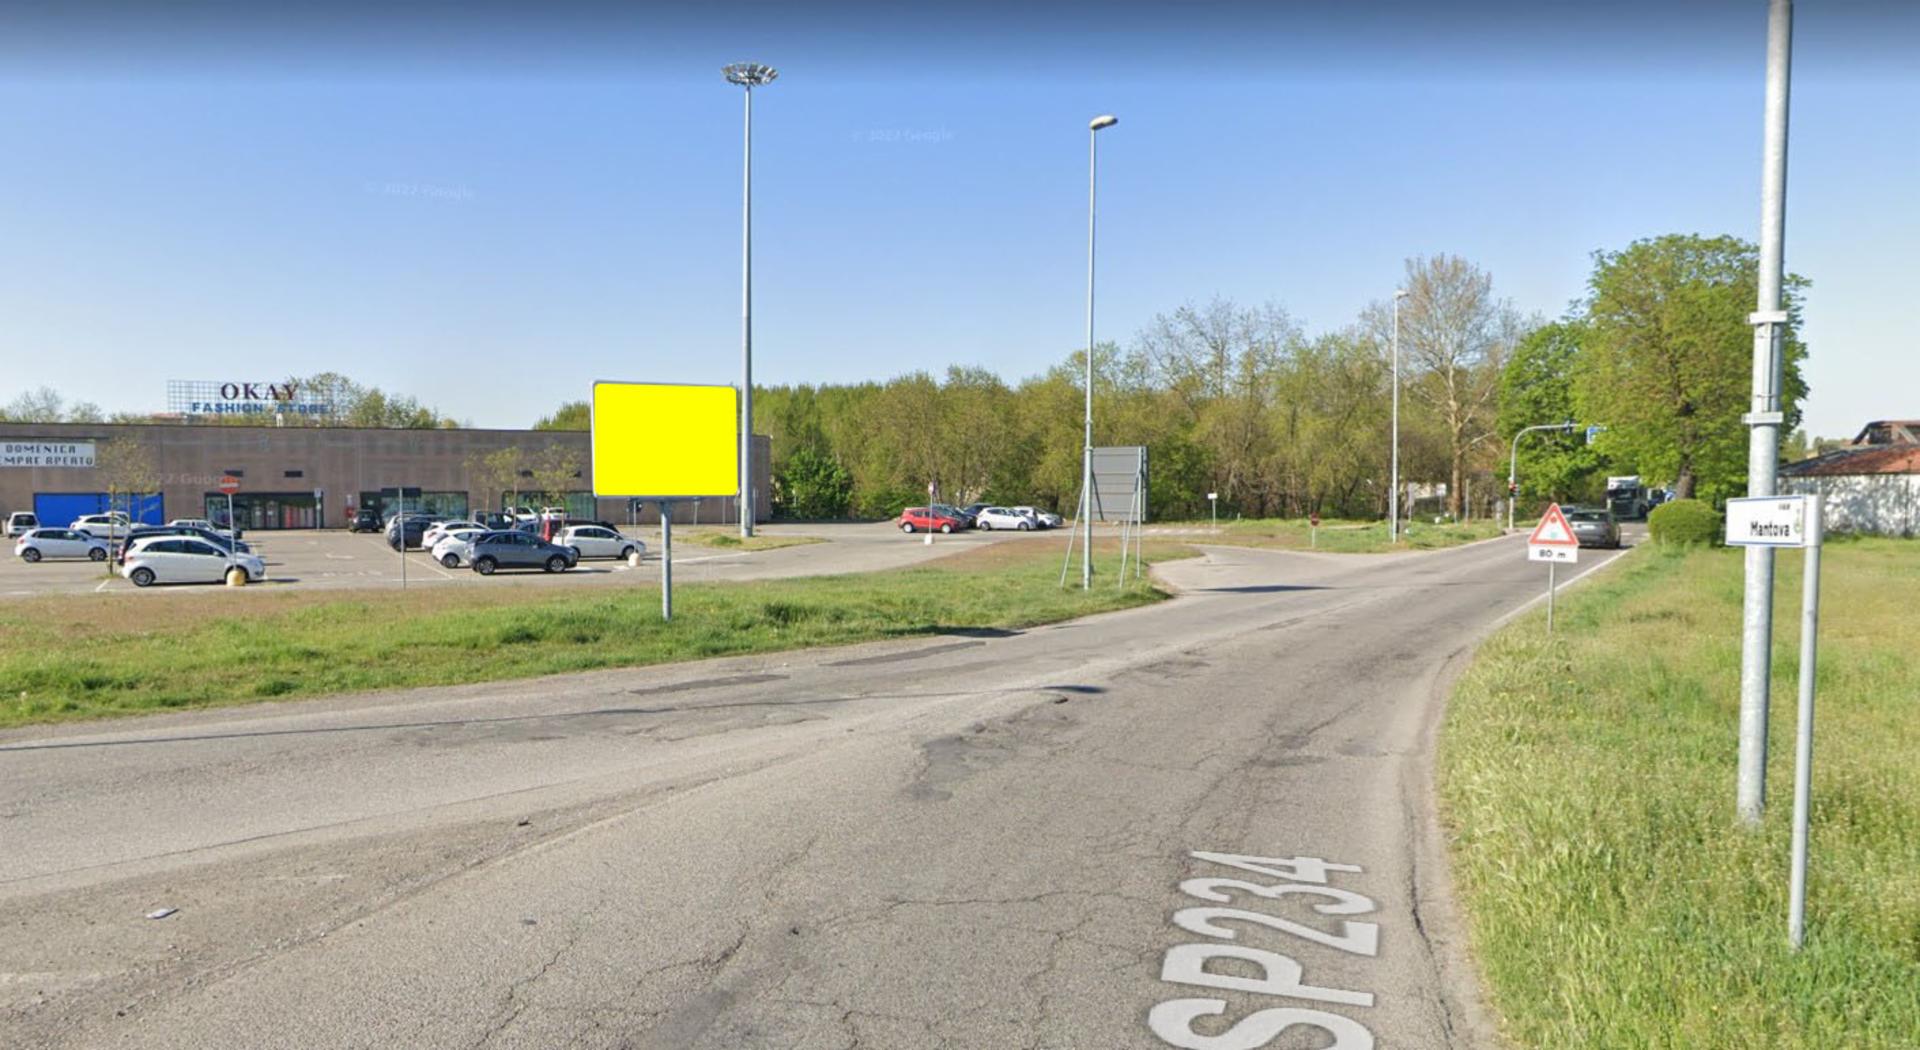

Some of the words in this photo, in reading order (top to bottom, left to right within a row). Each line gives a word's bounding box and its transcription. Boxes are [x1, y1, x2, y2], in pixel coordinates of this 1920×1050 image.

[220, 383, 299, 400] OKAY
[192, 402, 263, 413] FASHION
[277, 402, 329, 414] STORE
[5, 444, 76, 454] DOMENICA
[0, 456, 40, 465] MPRE
[45, 456, 93, 466] APERTO
[1750, 521, 1790, 537] Mantova
[1539, 549, 1553, 557] 80
